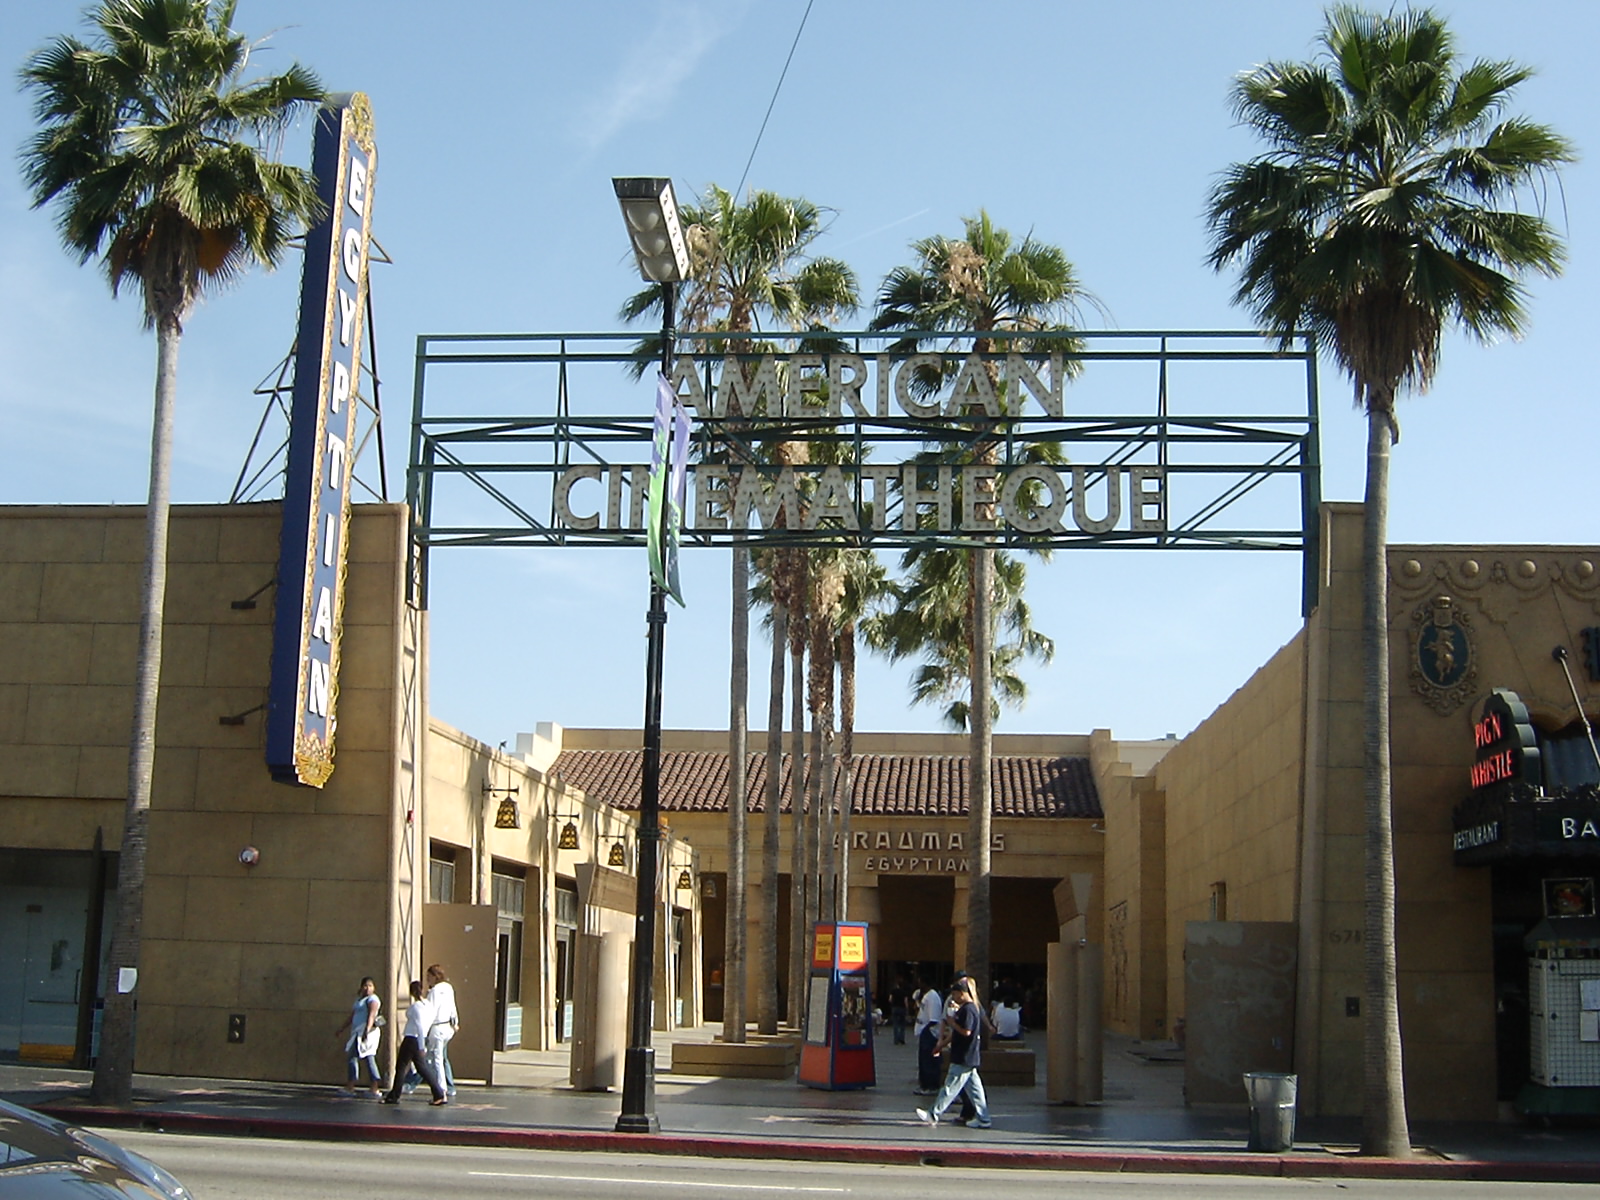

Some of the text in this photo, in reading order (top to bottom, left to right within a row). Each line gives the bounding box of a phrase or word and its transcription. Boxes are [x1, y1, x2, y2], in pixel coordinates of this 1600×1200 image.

[672, 352, 1065, 418] AMERICAN
[308, 154, 368, 718] EGYPTIAN
[553, 464, 1167, 534] CINEMATHEQUE
[1470, 748, 1513, 790] WHISTLE
[1453, 820, 1499, 851] RESTAURANT
[864, 856, 971, 872] EGYPTIAN
